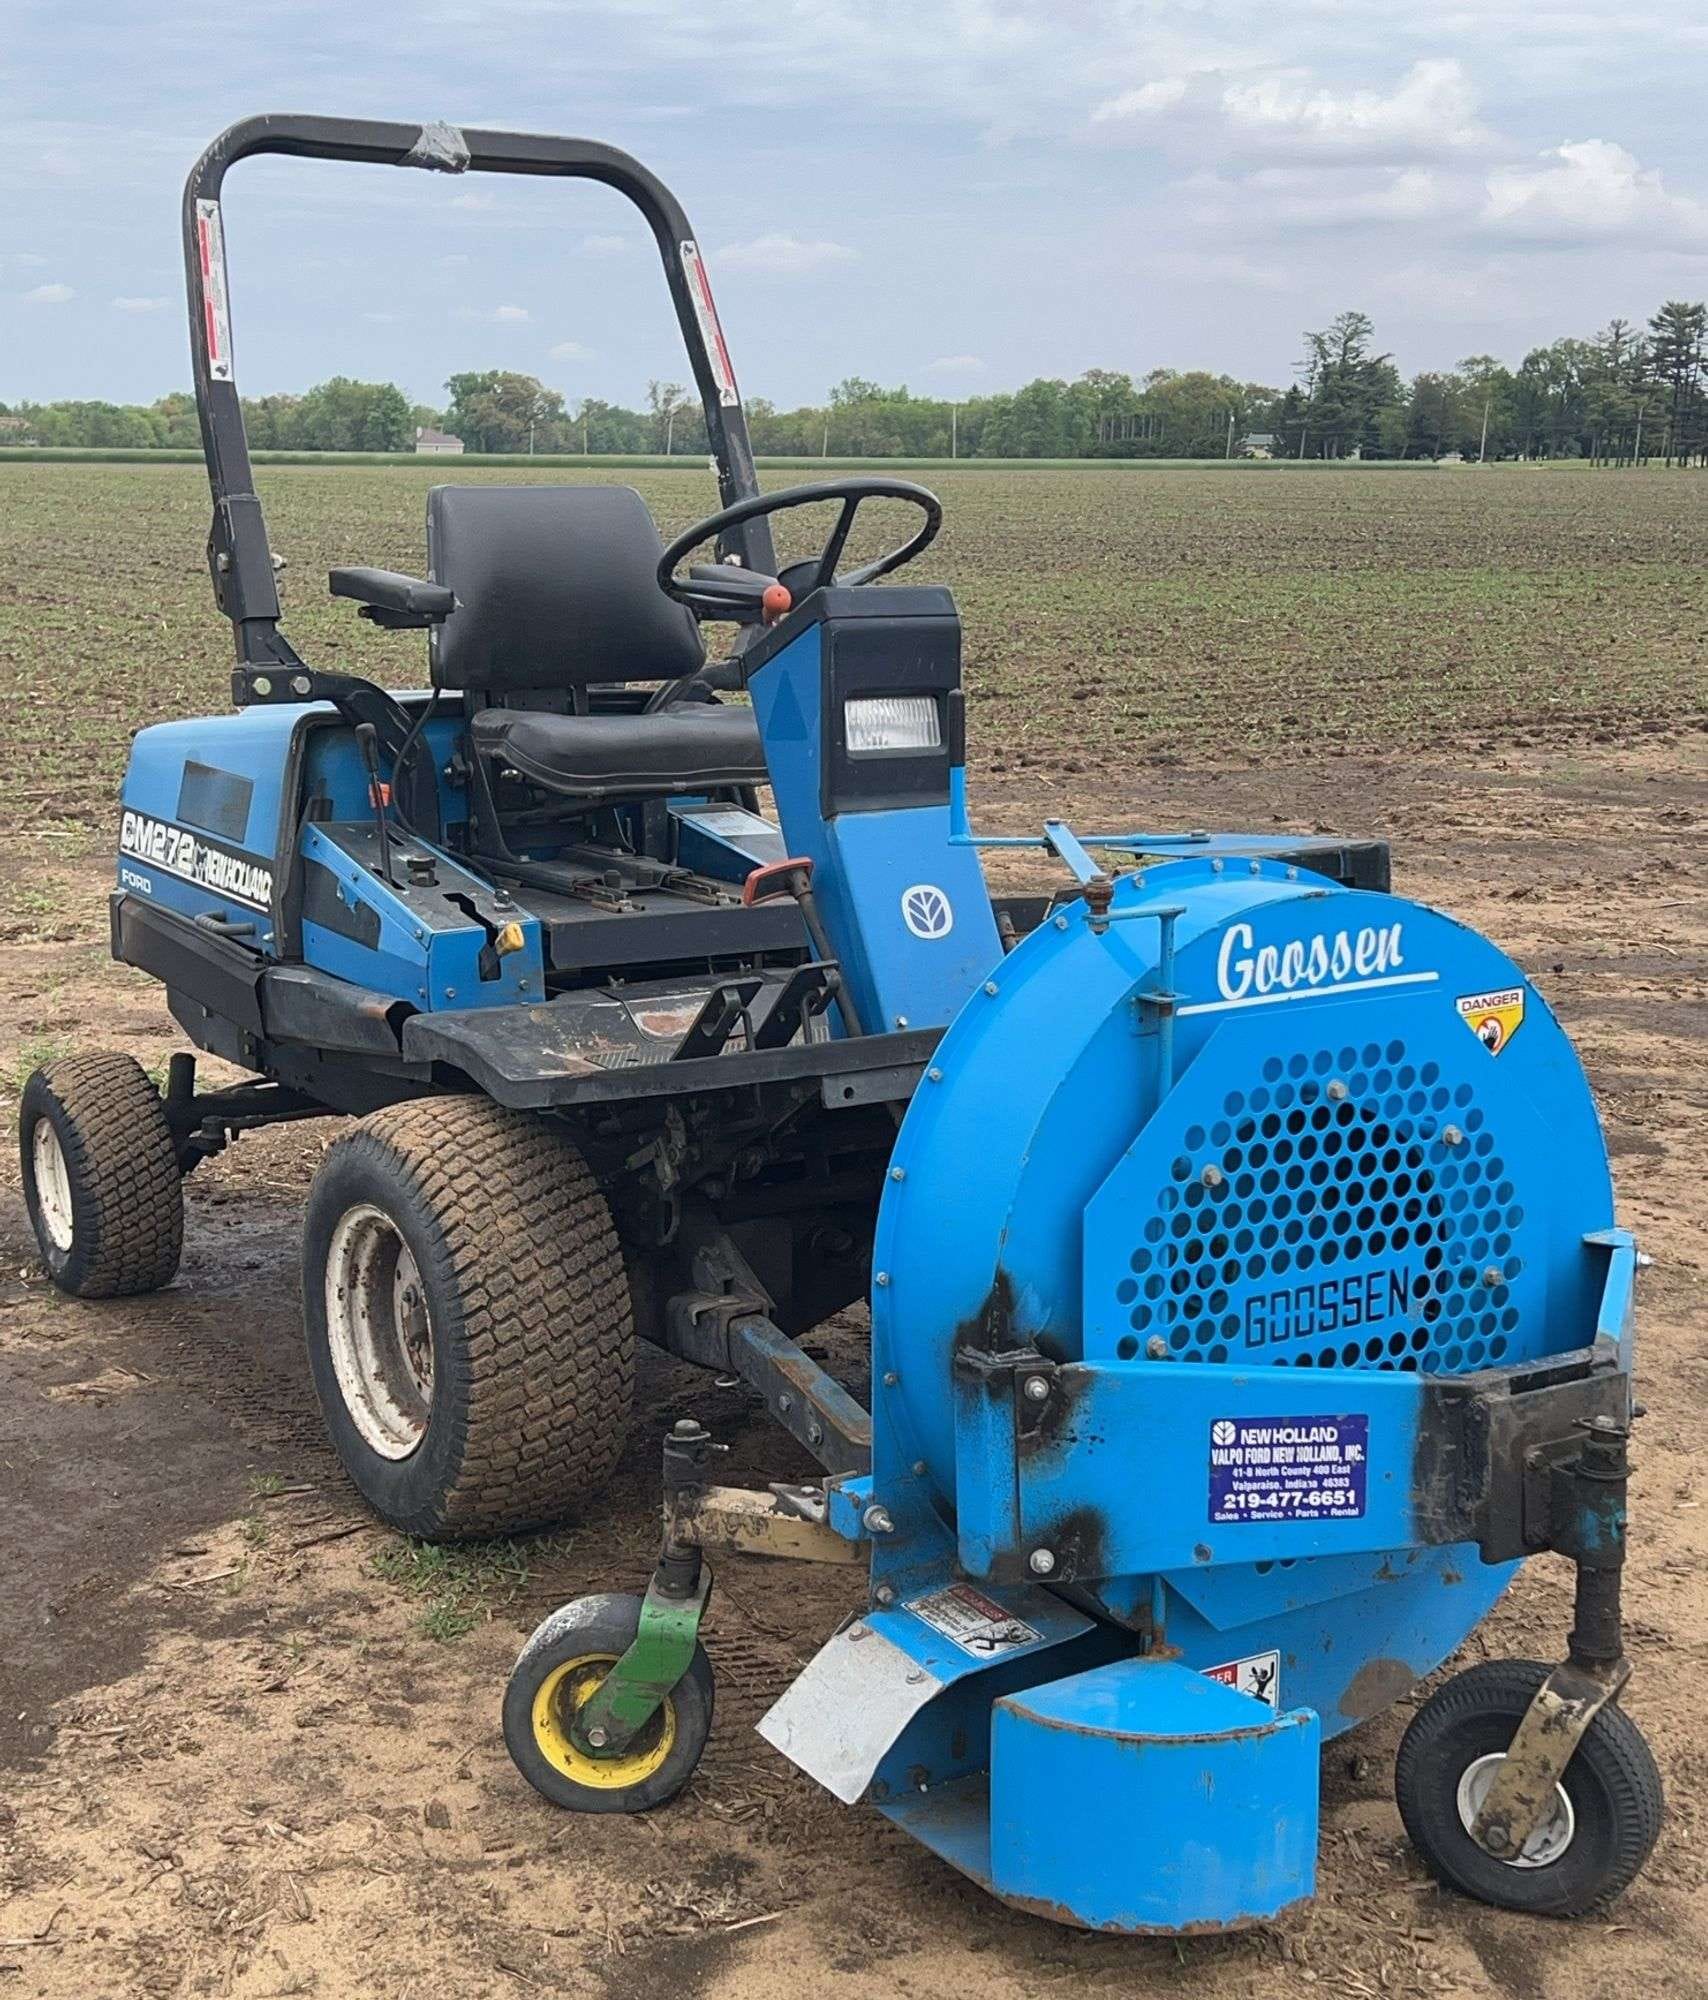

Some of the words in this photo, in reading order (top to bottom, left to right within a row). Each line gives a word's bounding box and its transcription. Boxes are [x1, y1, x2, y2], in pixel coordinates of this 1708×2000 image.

[121, 868, 152, 894] FORD
[1217, 922, 1404, 1001] Goossen
[1461, 992, 1520, 1012] DANGER
[1245, 1266, 1409, 1348] GOOSSEN
[1211, 1447, 1243, 1466] VALPO
[1245, 1447, 1271, 1464] FORD
[1272, 1446, 1295, 1464] NEW
[1296, 1445, 1343, 1464] HOLLAND,
[1255, 1467, 1279, 1477] North
[1281, 1465, 1311, 1477] County
[1331, 1464, 1351, 1475] East
[1223, 1489, 1356, 1509] 219-477-6651
[1214, 1511, 1239, 1521] Sales
[1250, 1509, 1284, 1519] Service
[1295, 1508, 1319, 1518] Parts
[1330, 1507, 1359, 1517] Rental
